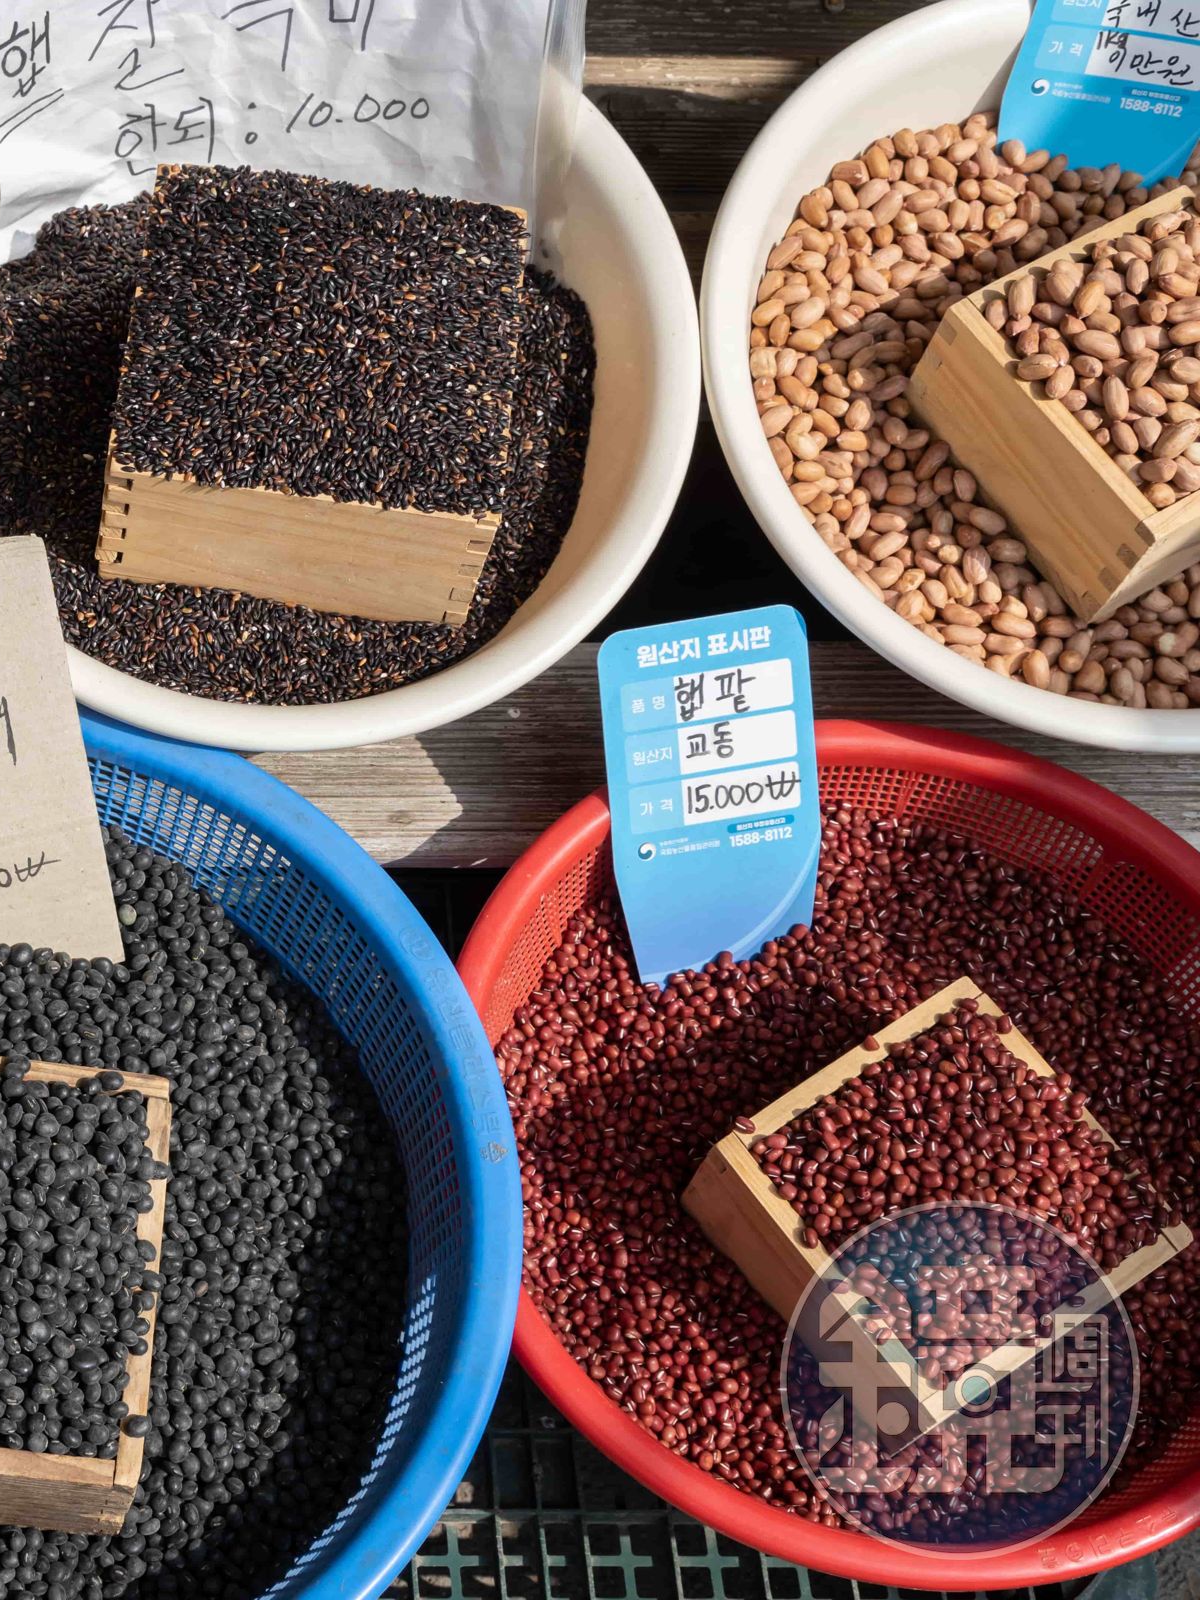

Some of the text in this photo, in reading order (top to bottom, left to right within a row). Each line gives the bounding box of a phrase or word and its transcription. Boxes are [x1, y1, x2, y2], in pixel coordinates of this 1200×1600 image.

[1118, 97, 1185, 119] 1588-8112
[636, 625, 772, 669] 원산지 표시판
[632, 720, 735, 767] 원산지 교동
[728, 826, 793, 847] 1588-8112
